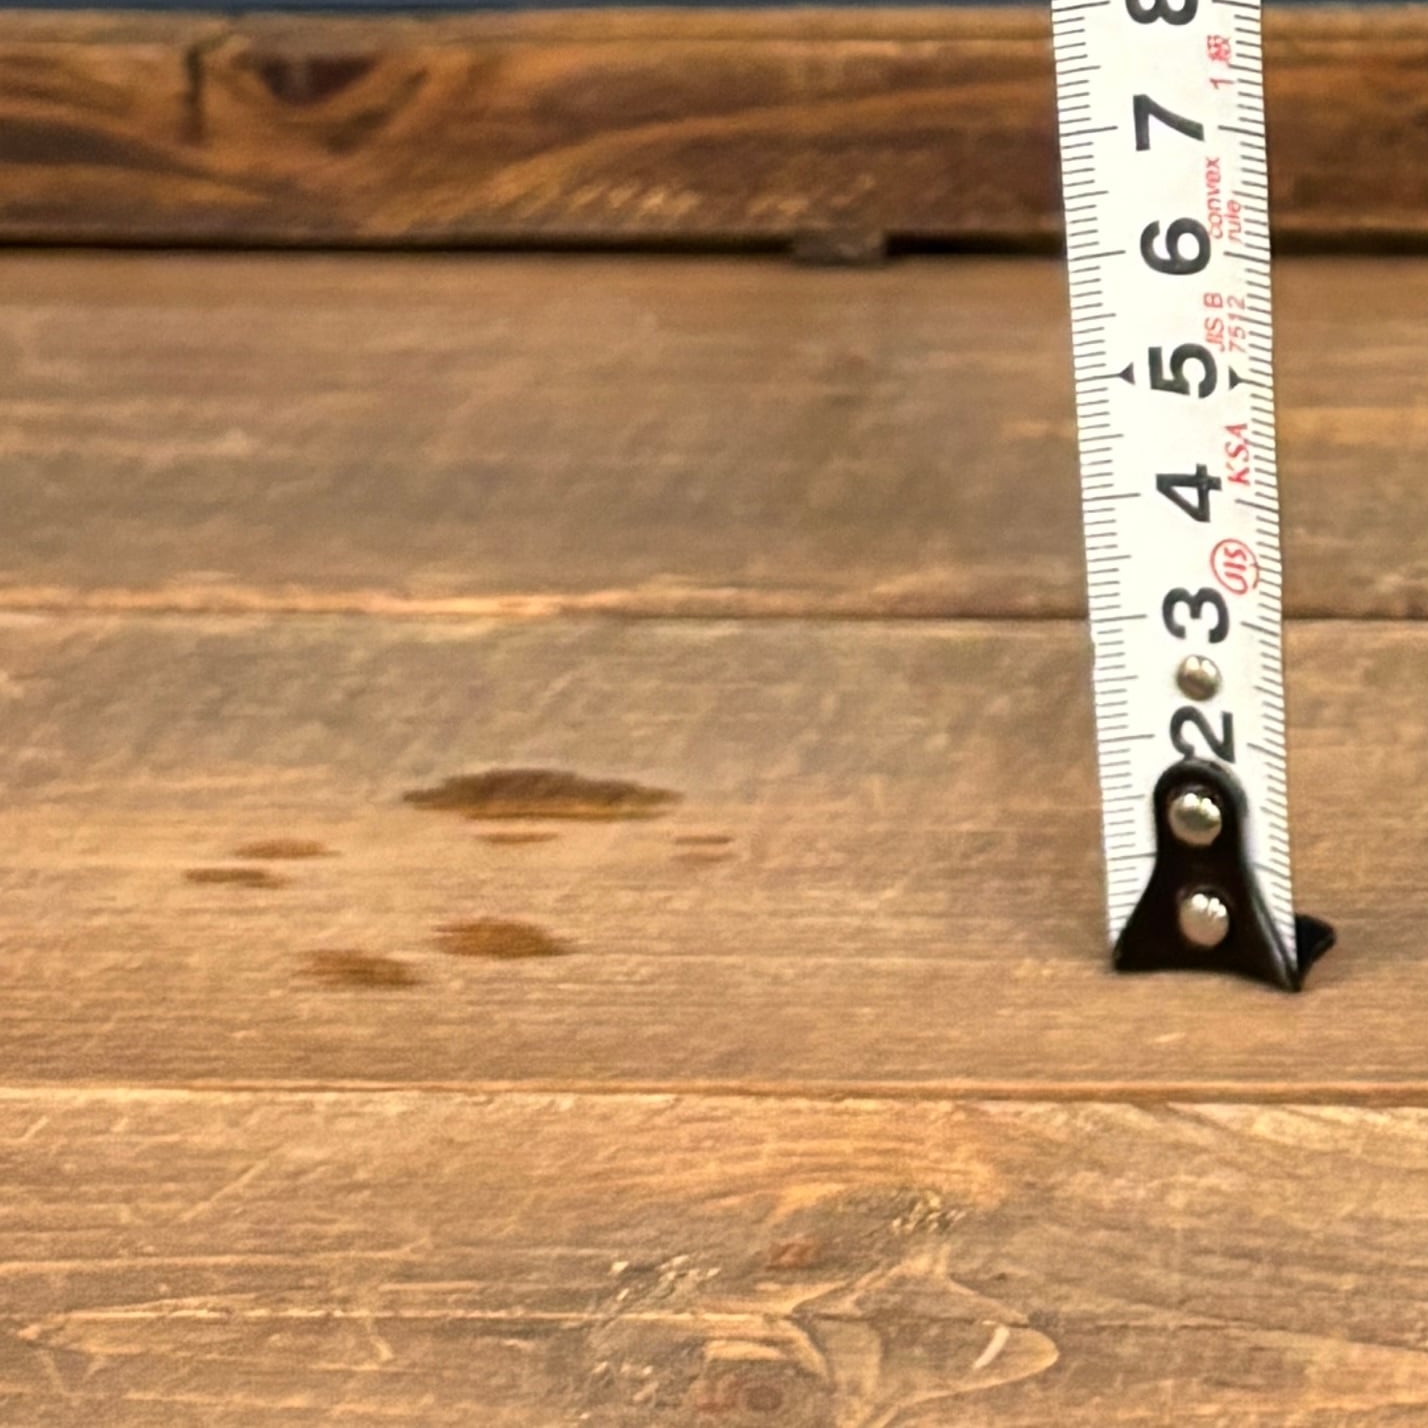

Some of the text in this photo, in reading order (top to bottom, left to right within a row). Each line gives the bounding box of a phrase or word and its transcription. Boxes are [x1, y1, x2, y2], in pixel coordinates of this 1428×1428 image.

[1133, 94, 1205, 152] 7
[1140, 217, 1211, 276] 6
[1148, 344, 1218, 399] 5
[1155, 464, 1222, 523] 4
[1162, 587, 1230, 644] 3
[1169, 705, 1236, 764] 2
